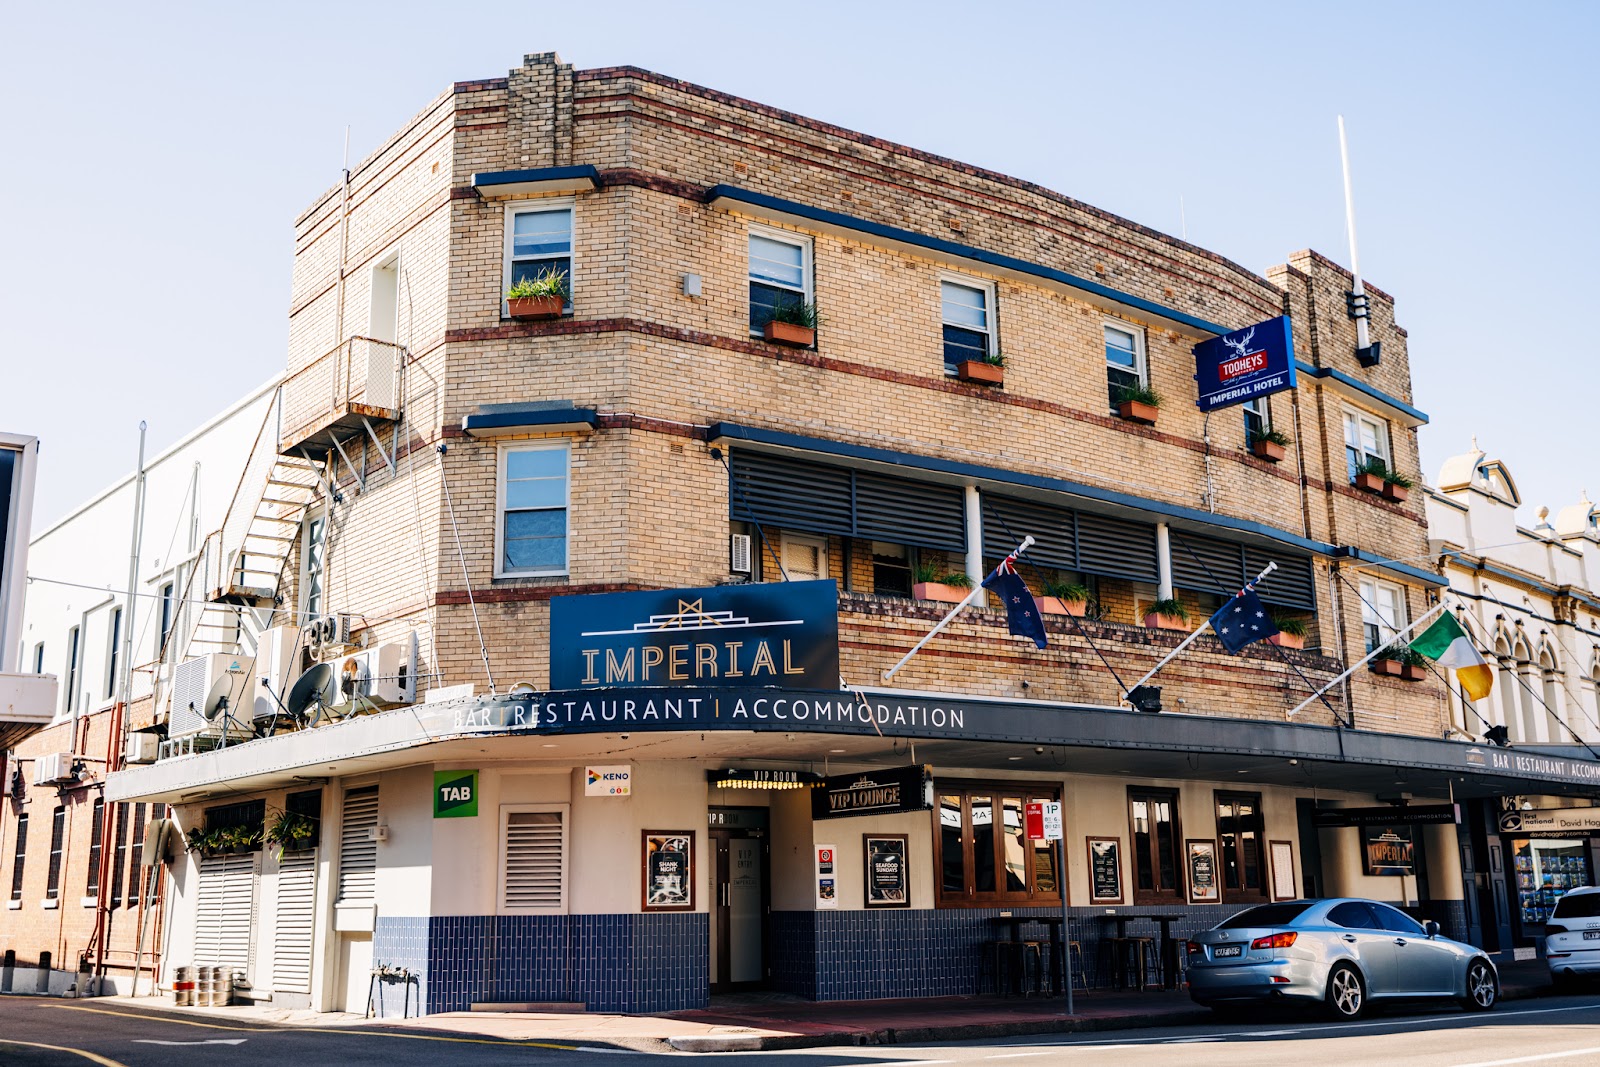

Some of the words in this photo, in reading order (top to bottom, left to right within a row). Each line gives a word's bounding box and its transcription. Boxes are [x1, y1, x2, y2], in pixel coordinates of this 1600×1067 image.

[1223, 354, 1263, 375] TOOHEYS
[1209, 386, 1252, 405] IMPERIAL
[1253, 377, 1284, 392] HOTEL
[581, 639, 805, 685] IMPERIAL
[454, 707, 491, 729] BAR
[514, 698, 702, 725] RESTAURANT
[732, 698, 964, 729] ACCOMMODATION
[1492, 753, 1509, 769] BAR
[1516, 756, 1565, 775] RESTAURANT
[603, 772, 629, 781] KENO
[754, 770, 769, 781] VIP
[774, 771, 798, 783] ROOM
[441, 786, 471, 801] TAB
[829, 792, 849, 809] VIP
[852, 786, 901, 807] LOUNGE
[1046, 805, 1058, 814] 1P
[708, 813, 717, 824] IP
[1560, 819, 1582, 828] David
[1371, 845, 1412, 862] IMPERIAL
